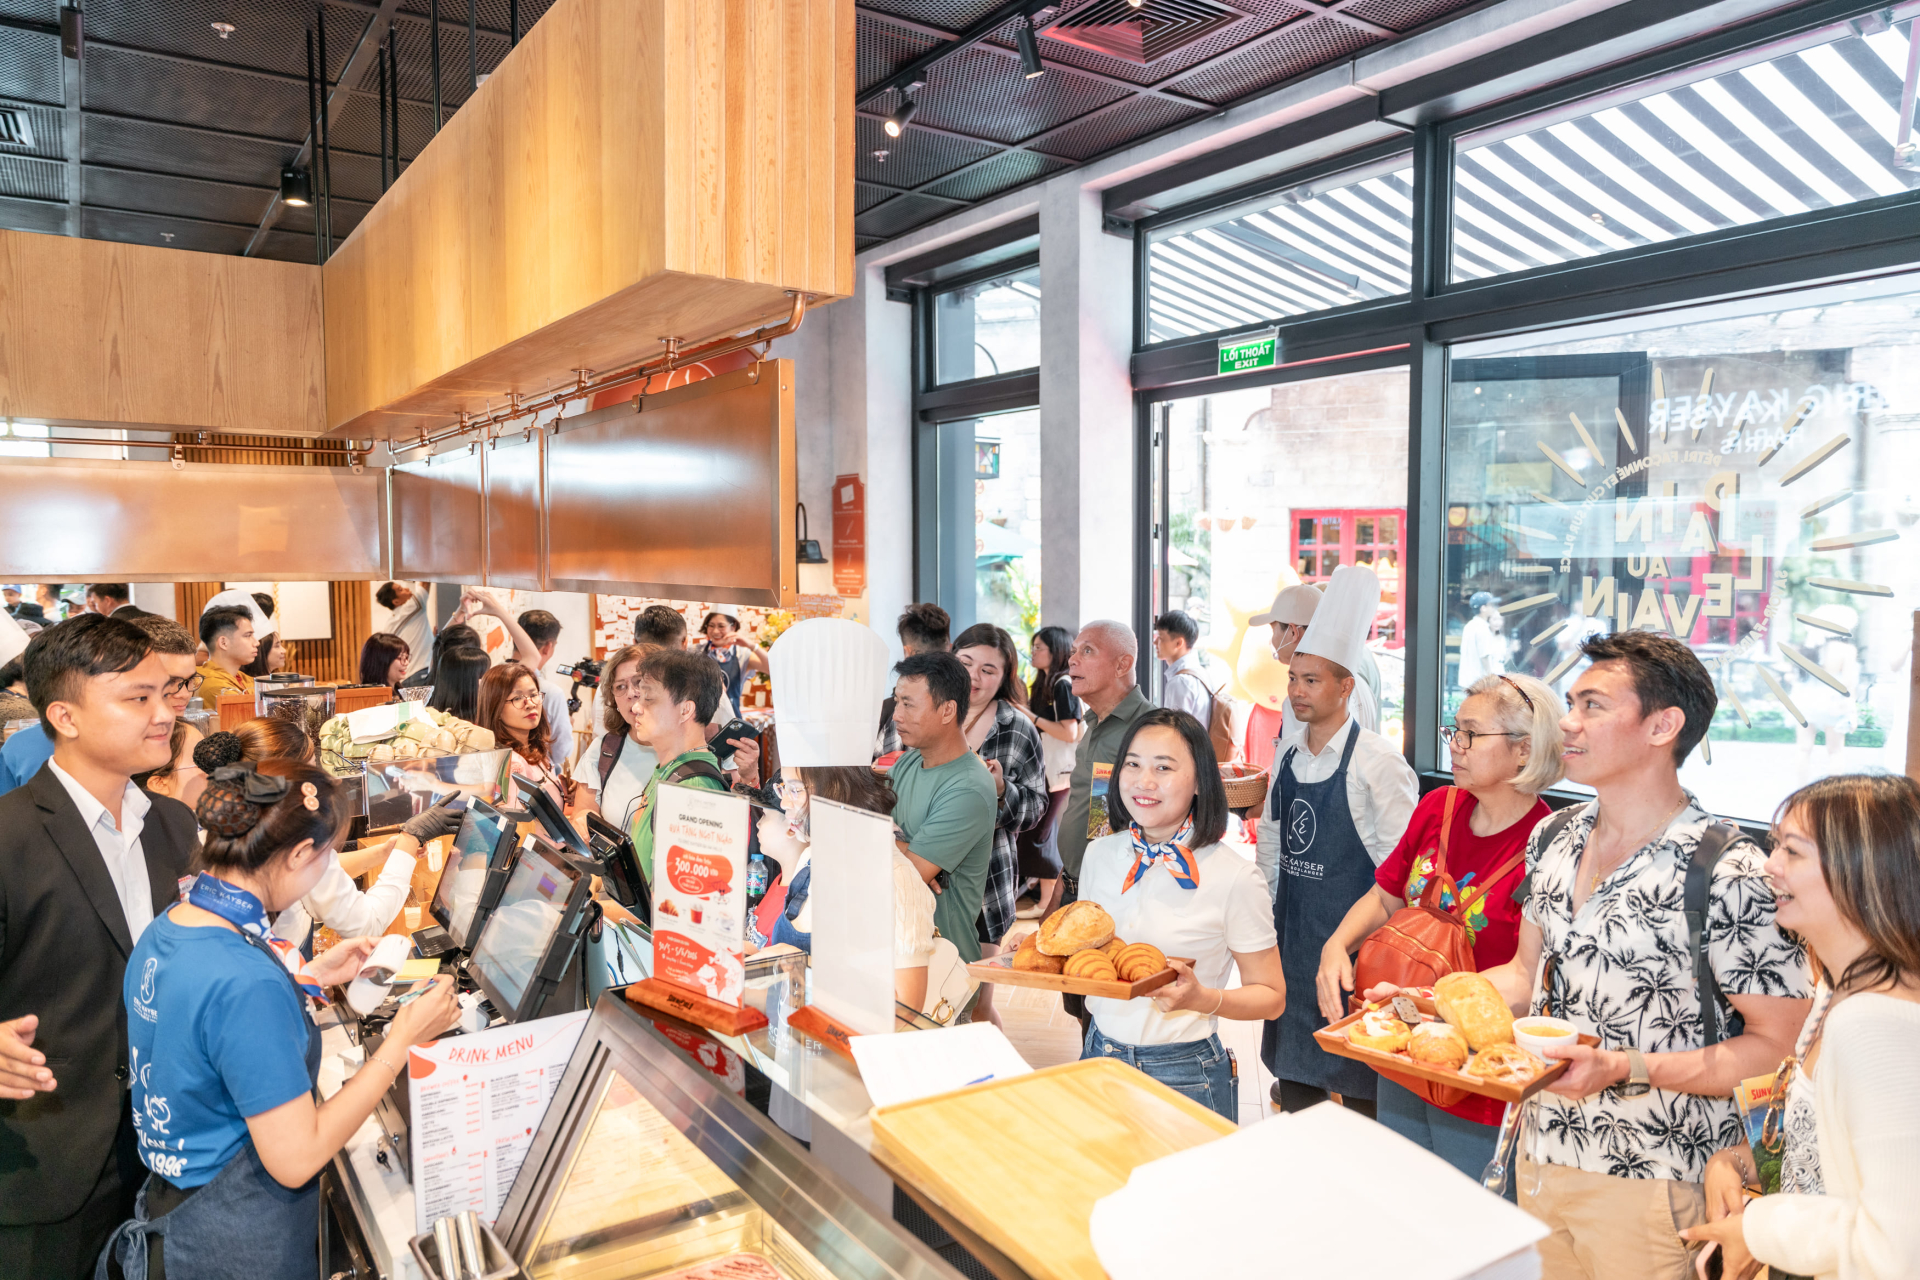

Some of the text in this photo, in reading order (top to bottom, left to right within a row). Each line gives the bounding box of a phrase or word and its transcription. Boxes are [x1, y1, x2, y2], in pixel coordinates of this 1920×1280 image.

[1223, 343, 1271, 362] LỐI THOÁT
[1234, 358, 1259, 369] EXIT
[678, 813, 723, 829] GRAND OPENING
[674, 857, 709, 878] 300.000
[1289, 858, 1324, 872] KAYSER
[200, 883, 217, 895] ERIC
[219, 891, 254, 910] KAYSER
[448, 1034, 534, 1064] DRINK MENU
[148, 1151, 188, 1178] 1996
